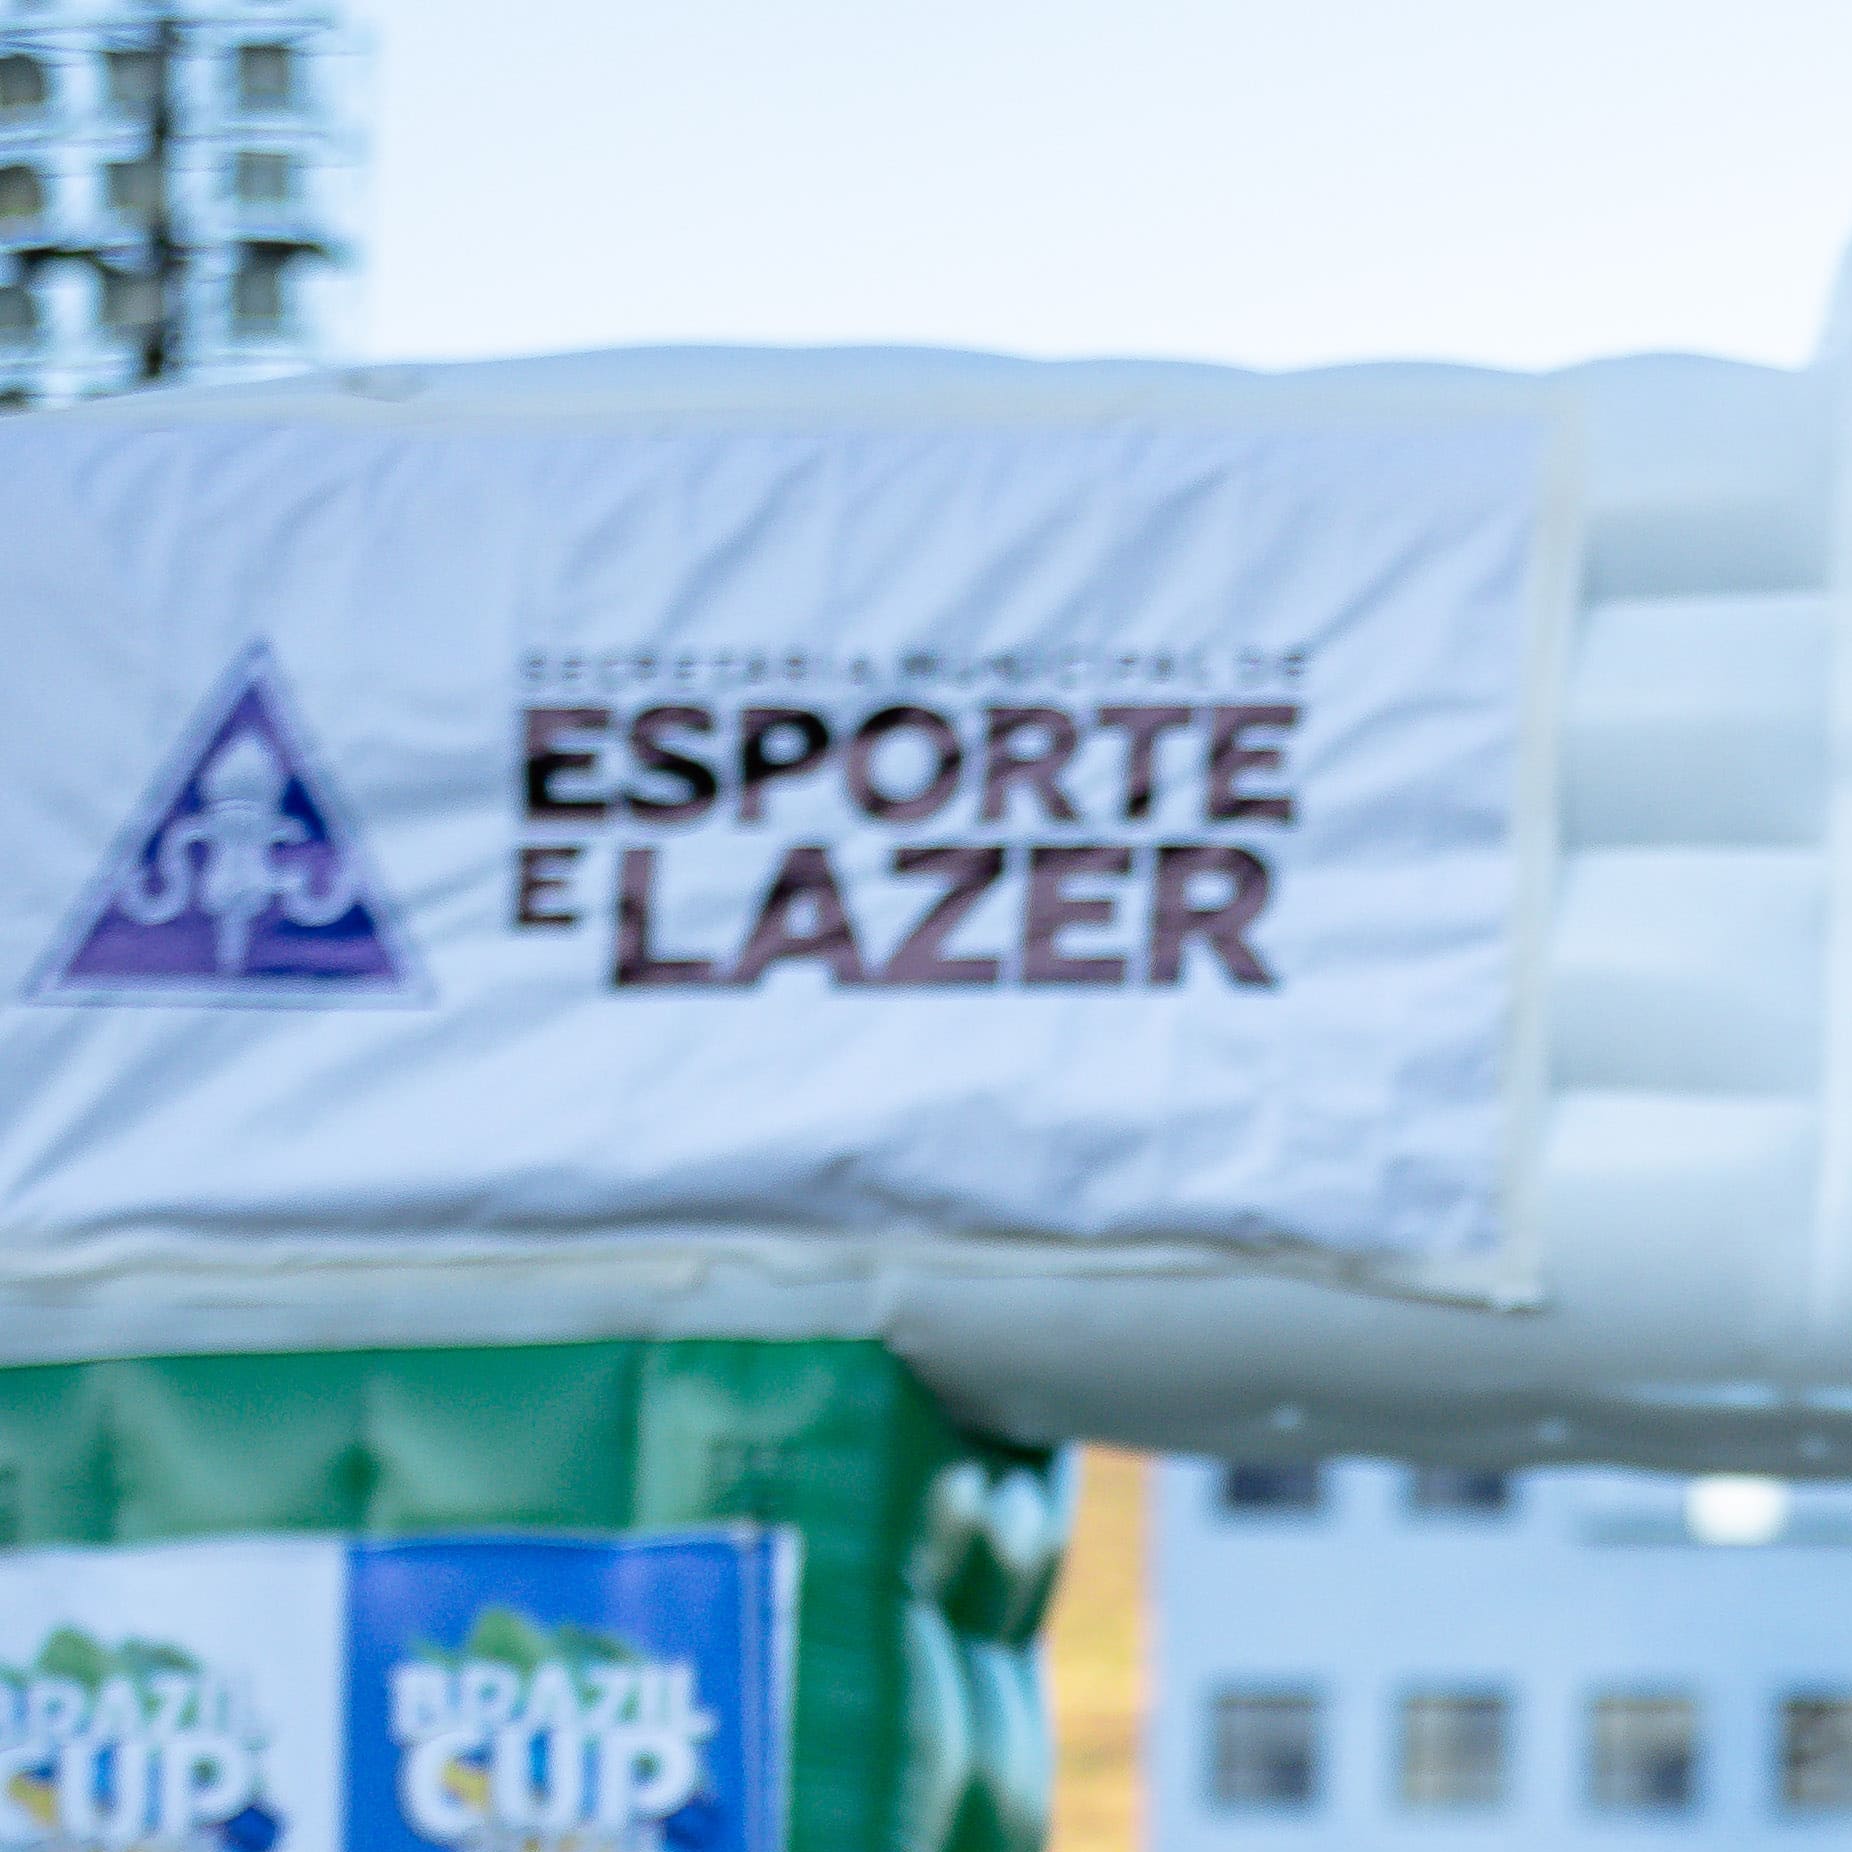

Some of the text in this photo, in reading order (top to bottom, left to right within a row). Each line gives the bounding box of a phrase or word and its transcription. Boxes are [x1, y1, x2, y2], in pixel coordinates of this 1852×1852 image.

[523, 704, 1300, 826] ESPORTE
[513, 844, 1277, 987] E LAZER
[390, 1661, 719, 1743] BRAZIL
[404, 1729, 703, 1844] CUP
